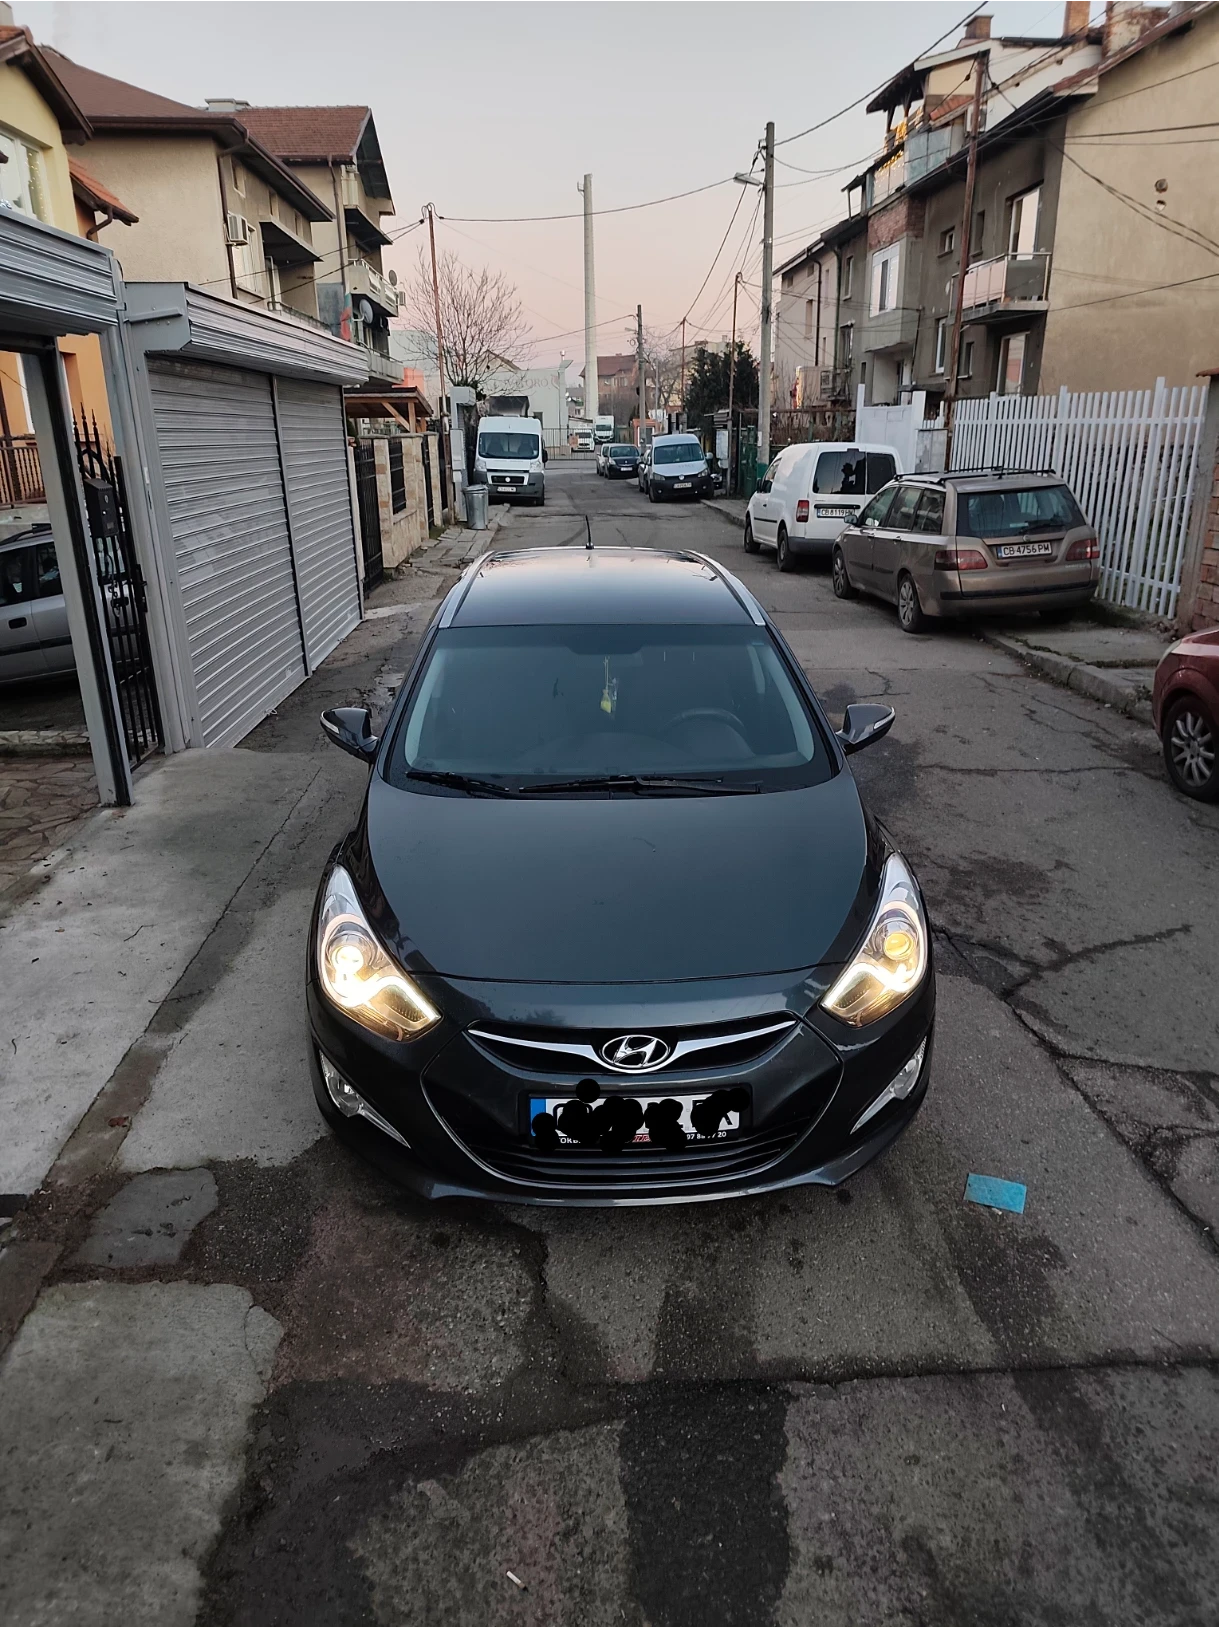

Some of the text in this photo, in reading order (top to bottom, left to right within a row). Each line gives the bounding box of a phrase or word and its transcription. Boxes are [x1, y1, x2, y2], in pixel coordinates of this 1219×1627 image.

[1003, 544, 1050, 556] CB 4756 PM
